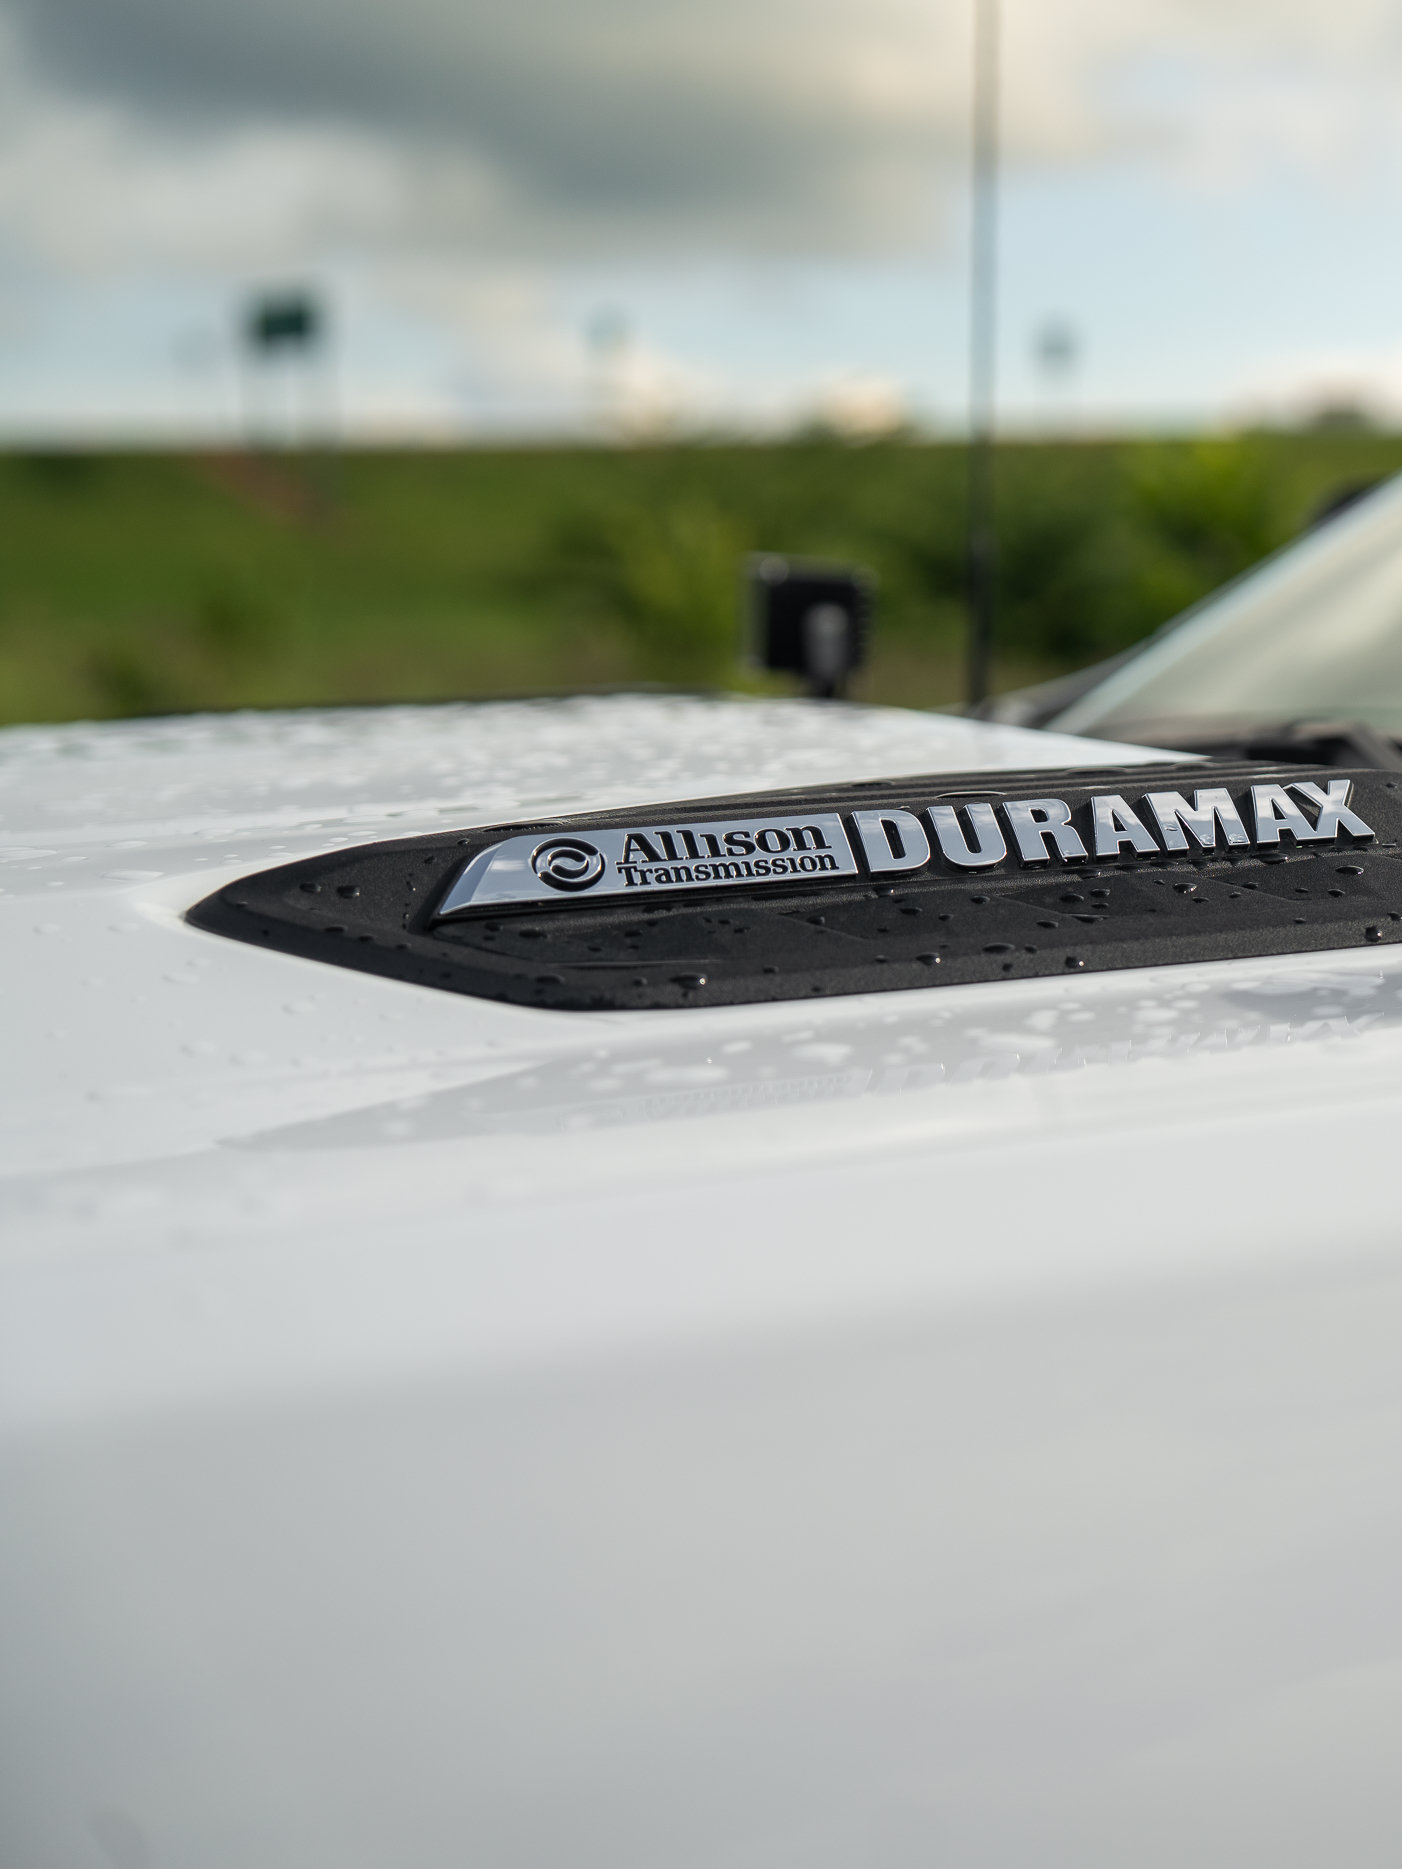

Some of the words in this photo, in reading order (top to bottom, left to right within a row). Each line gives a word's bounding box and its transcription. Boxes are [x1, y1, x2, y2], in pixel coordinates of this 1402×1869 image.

[616, 824, 832, 865] Allison
[850, 779, 1376, 877] DURAMAX
[616, 853, 840, 887] Transmission
